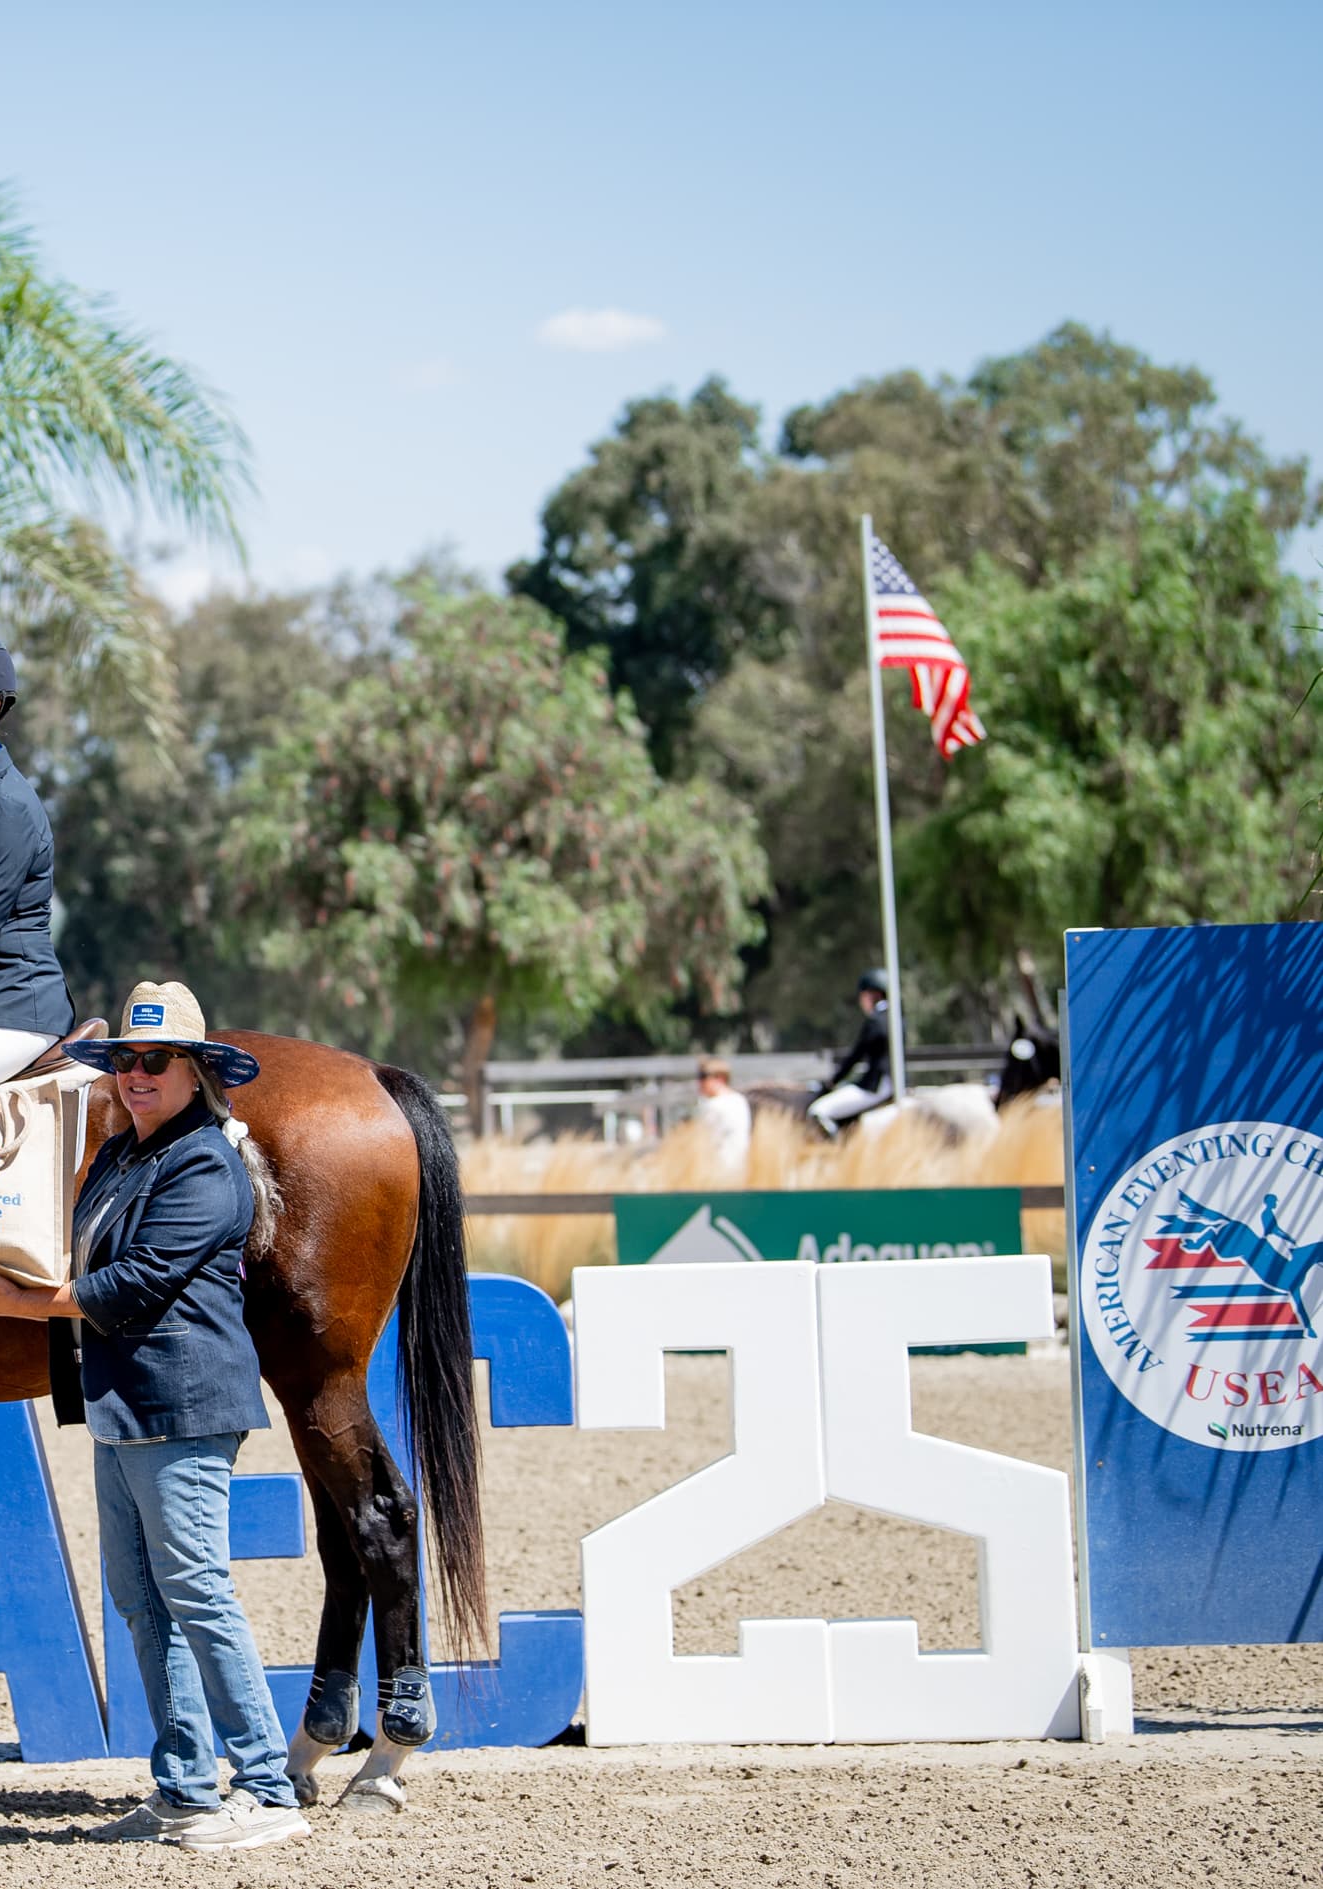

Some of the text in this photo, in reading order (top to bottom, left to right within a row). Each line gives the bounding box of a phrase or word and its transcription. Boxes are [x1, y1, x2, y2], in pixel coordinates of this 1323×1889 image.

[1120, 1132, 1275, 1211] EVENTING
[1095, 1212, 1164, 1374] AMERICAN
[1185, 1362, 1323, 1407] USEA
[1232, 1423, 1301, 1438] Nutrena
[573, 1254, 1079, 1747] 25
